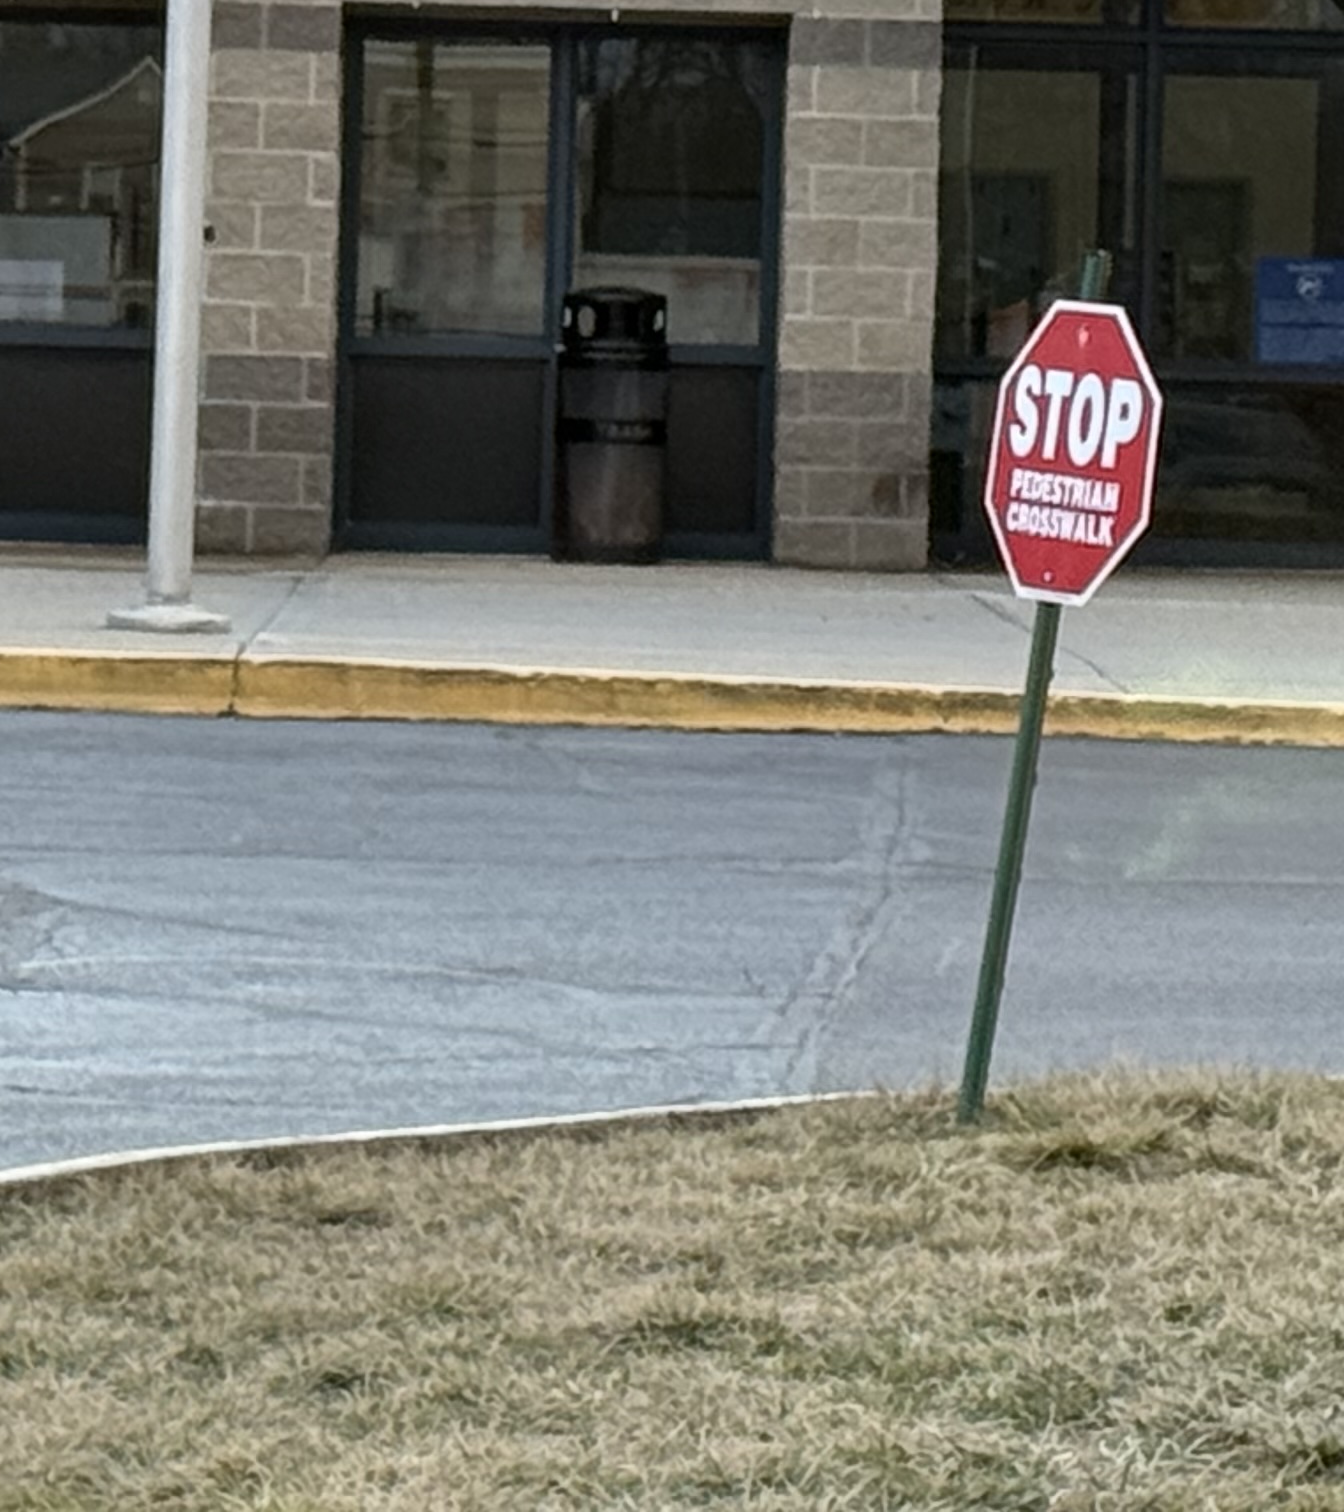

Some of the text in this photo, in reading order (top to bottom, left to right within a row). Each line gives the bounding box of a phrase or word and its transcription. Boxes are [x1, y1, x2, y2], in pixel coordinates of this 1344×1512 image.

[1009, 363, 1144, 470] STOP
[1010, 467, 1121, 513] PEDESTRIAN
[1006, 501, 1115, 547] CROSSWALK
